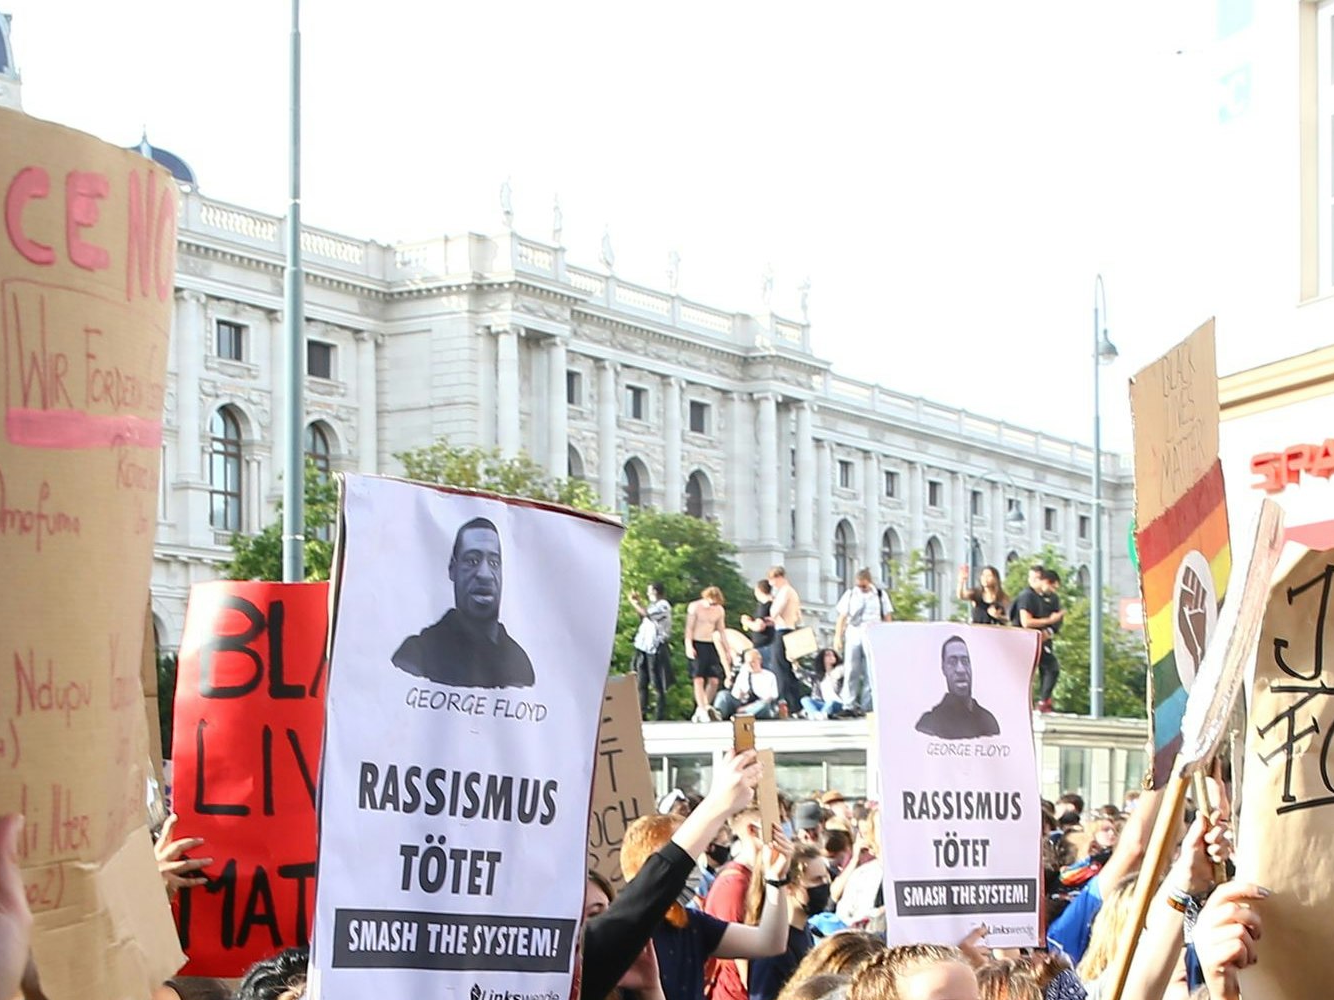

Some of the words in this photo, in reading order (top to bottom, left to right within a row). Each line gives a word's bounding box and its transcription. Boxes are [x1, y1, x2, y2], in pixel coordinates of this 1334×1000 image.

[405, 687, 486, 714] GEORGE
[493, 698, 549, 724] FLOYD
[926, 742, 972, 757] GEORGE
[974, 742, 1011, 758] FLOYD
[358, 760, 559, 827] RASSISMUS
[901, 789, 1023, 822] RASSISMUS
[399, 833, 503, 896] TÖTET
[933, 831, 991, 868] TÖTET
[903, 886, 947, 907] SMASH
[951, 886, 977, 906] THE
[977, 884, 1029, 906] SYSTEM!
[348, 919, 418, 954] SMASH
[426, 922, 468, 956] THE
[471, 925, 560, 959] SYSTEM!
